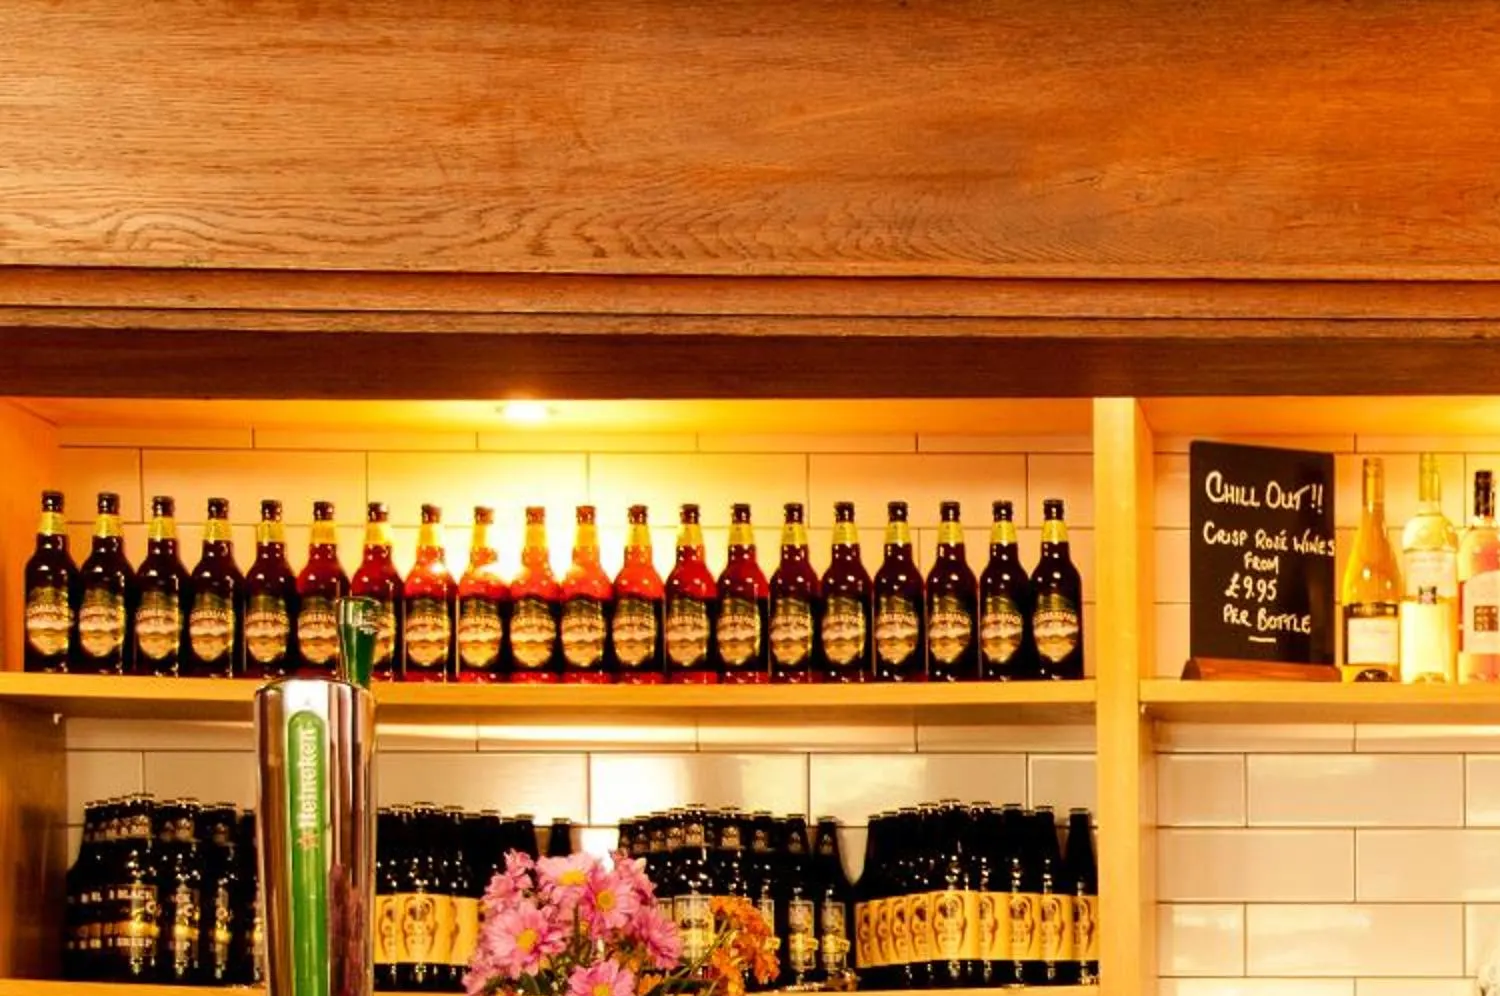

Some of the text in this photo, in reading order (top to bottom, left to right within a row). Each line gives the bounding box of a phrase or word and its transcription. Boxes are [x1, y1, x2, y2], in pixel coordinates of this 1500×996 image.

[1205, 470, 1260, 508] CHILL
[1203, 520, 1248, 545] CRISP
[1292, 528, 1335, 557] WINES
[1244, 551, 1279, 574] FROM
[1224, 572, 1277, 603] £9.95
[1223, 602, 1311, 634] PER BOTTLE
